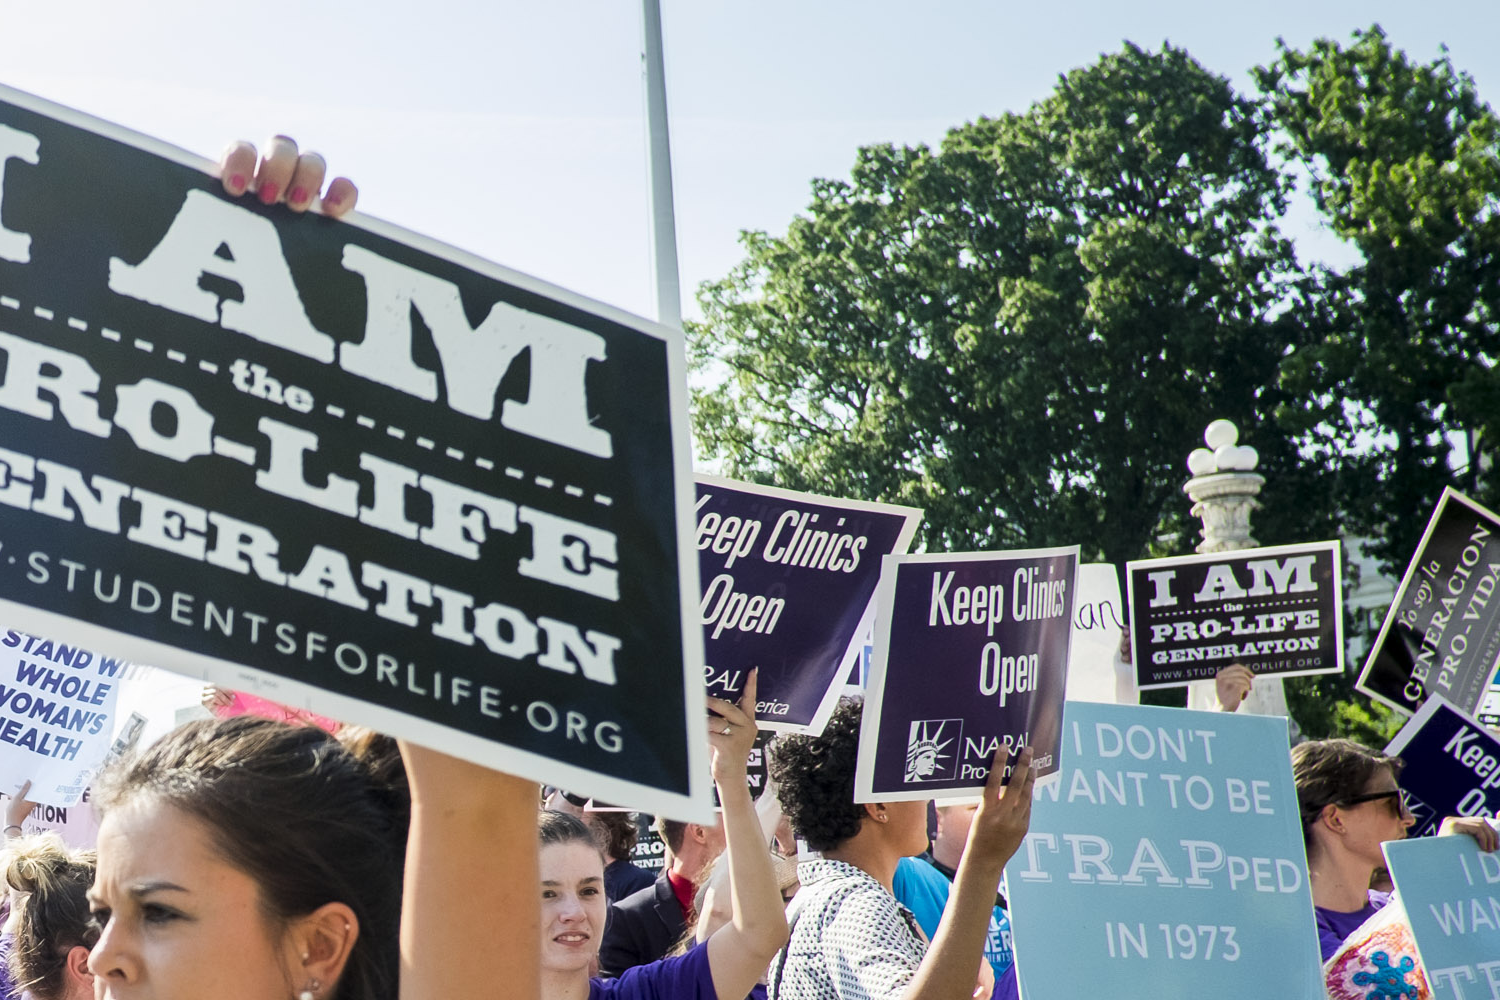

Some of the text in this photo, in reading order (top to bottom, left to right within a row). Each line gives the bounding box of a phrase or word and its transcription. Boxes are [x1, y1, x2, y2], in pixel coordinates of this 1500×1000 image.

[108, 188, 613, 458] AM
[230, 358, 314, 413] the
[694, 494, 868, 573] eep Clinics
[700, 574, 786, 640] Open
[929, 566, 1066, 636] Keep Clinics
[1148, 555, 1318, 607] I AM
[1223, 602, 1243, 612] the
[1398, 560, 1441, 630] Yo soy la
[1150, 609, 1320, 643] PRO-LIFE
[1404, 522, 1491, 701] GENERACION
[1, 632, 95, 669] STAND
[98, 655, 144, 680] WI
[979, 642, 1038, 707] Open
[1152, 636, 1321, 664] GENERATION
[15, 660, 111, 706] WHOLE
[1073, 721, 1217, 765] I DON'T
[1160, 774, 1214, 811] TO
[1226, 777, 1275, 815] BE
[1020, 831, 1301, 893] TRAPPED
[1459, 853, 1474, 886] I
[1105, 922, 1241, 961] IN 1973
